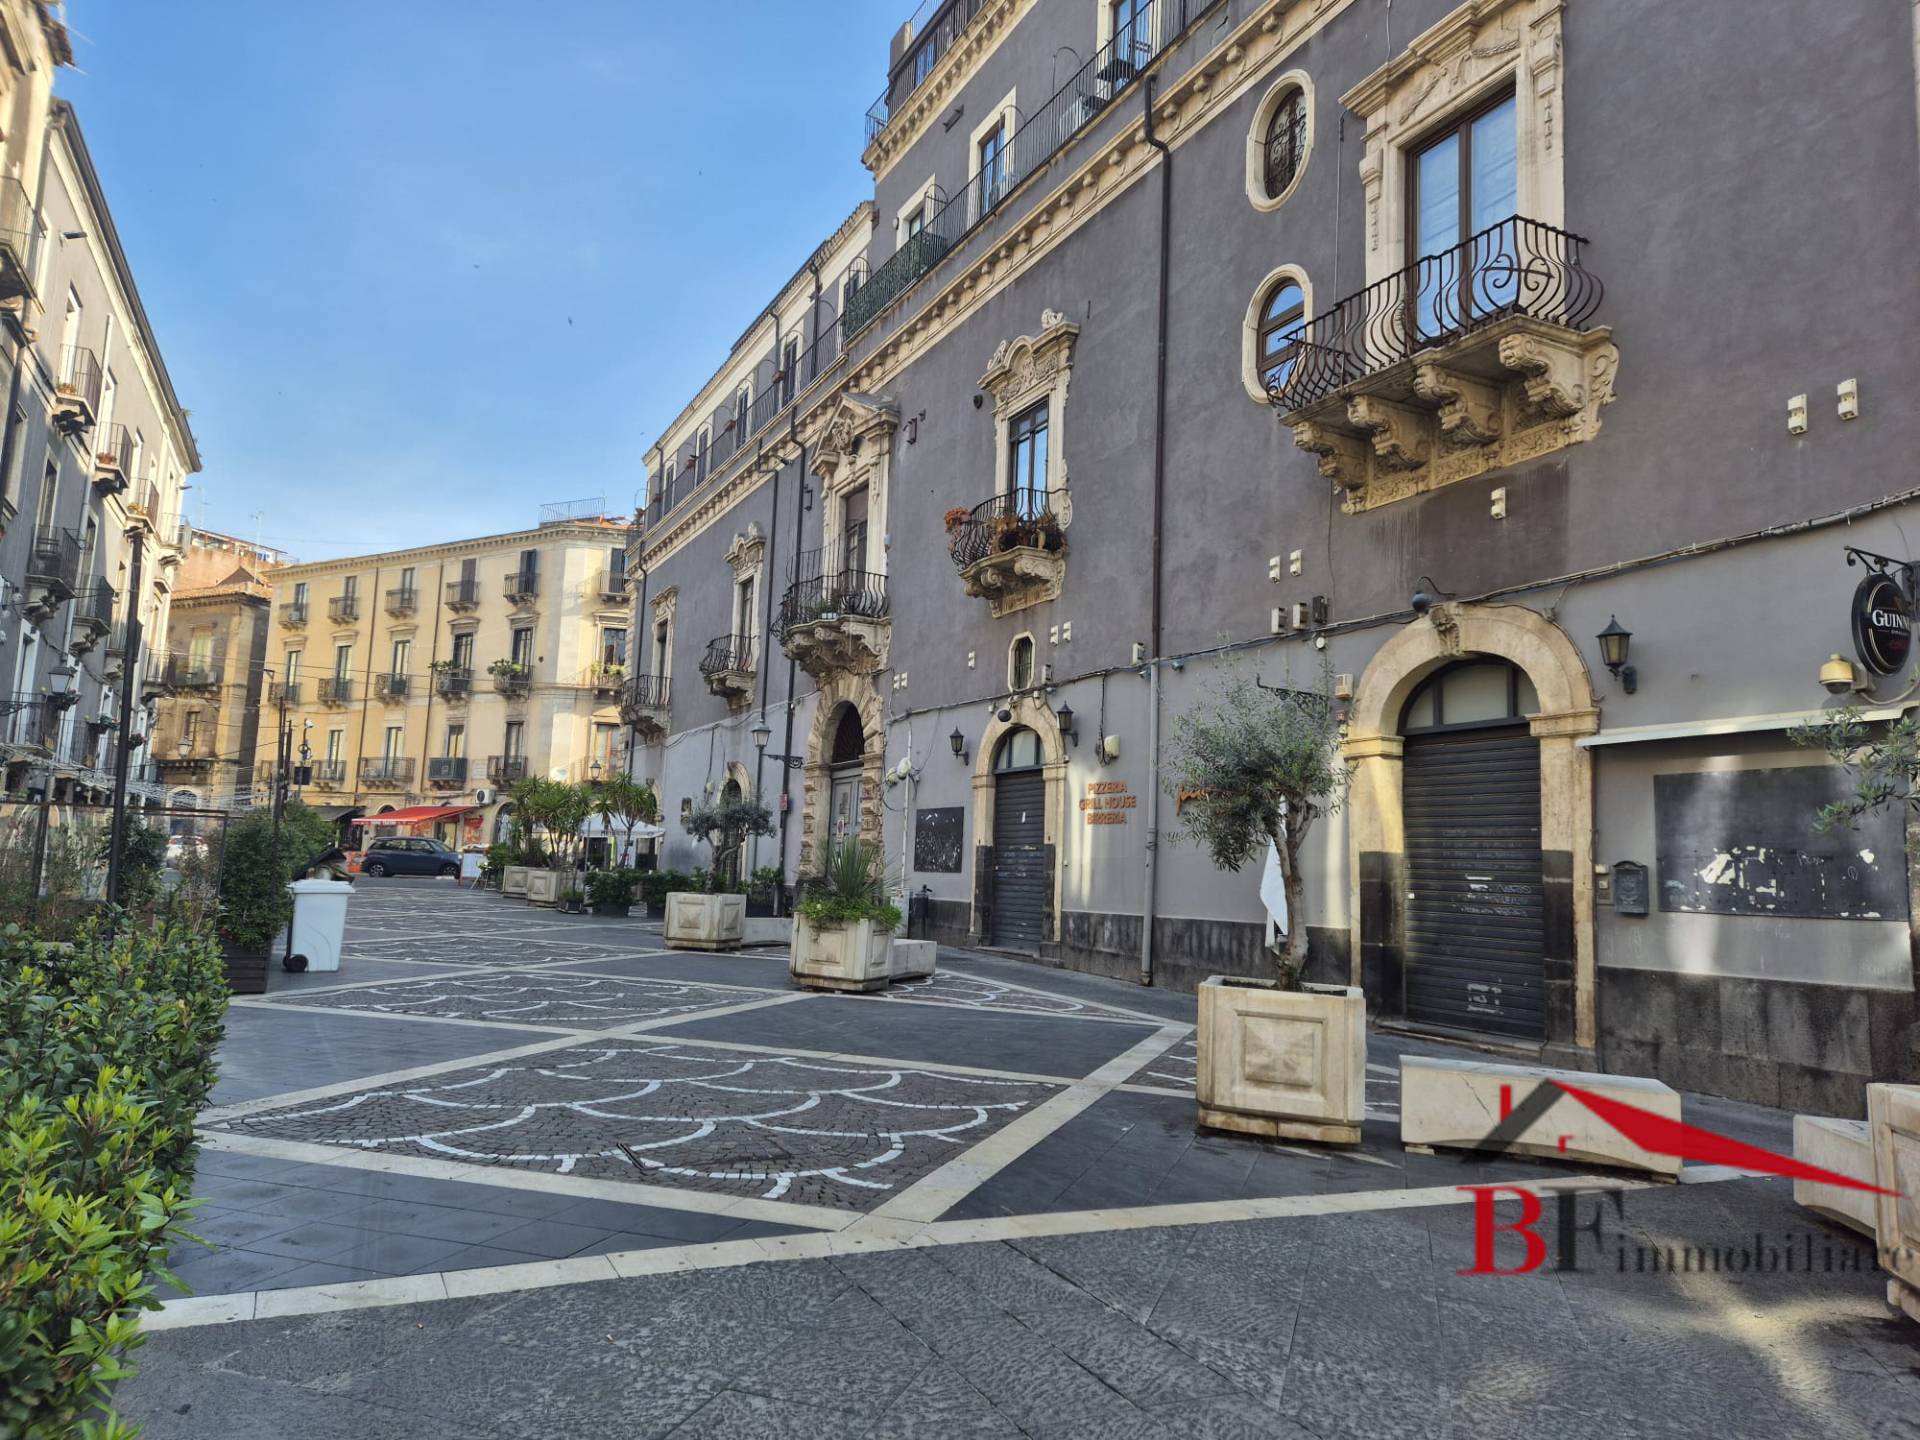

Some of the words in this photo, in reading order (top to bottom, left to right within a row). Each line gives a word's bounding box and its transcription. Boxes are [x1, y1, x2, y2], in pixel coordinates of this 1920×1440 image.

[1872, 609, 1910, 630] GUINN
[1088, 783, 1127, 795] PIZZERIA
[1079, 798, 1102, 810] GRILL
[1104, 795, 1136, 809] HOUSE
[1087, 812, 1127, 825] BIRRERIA
